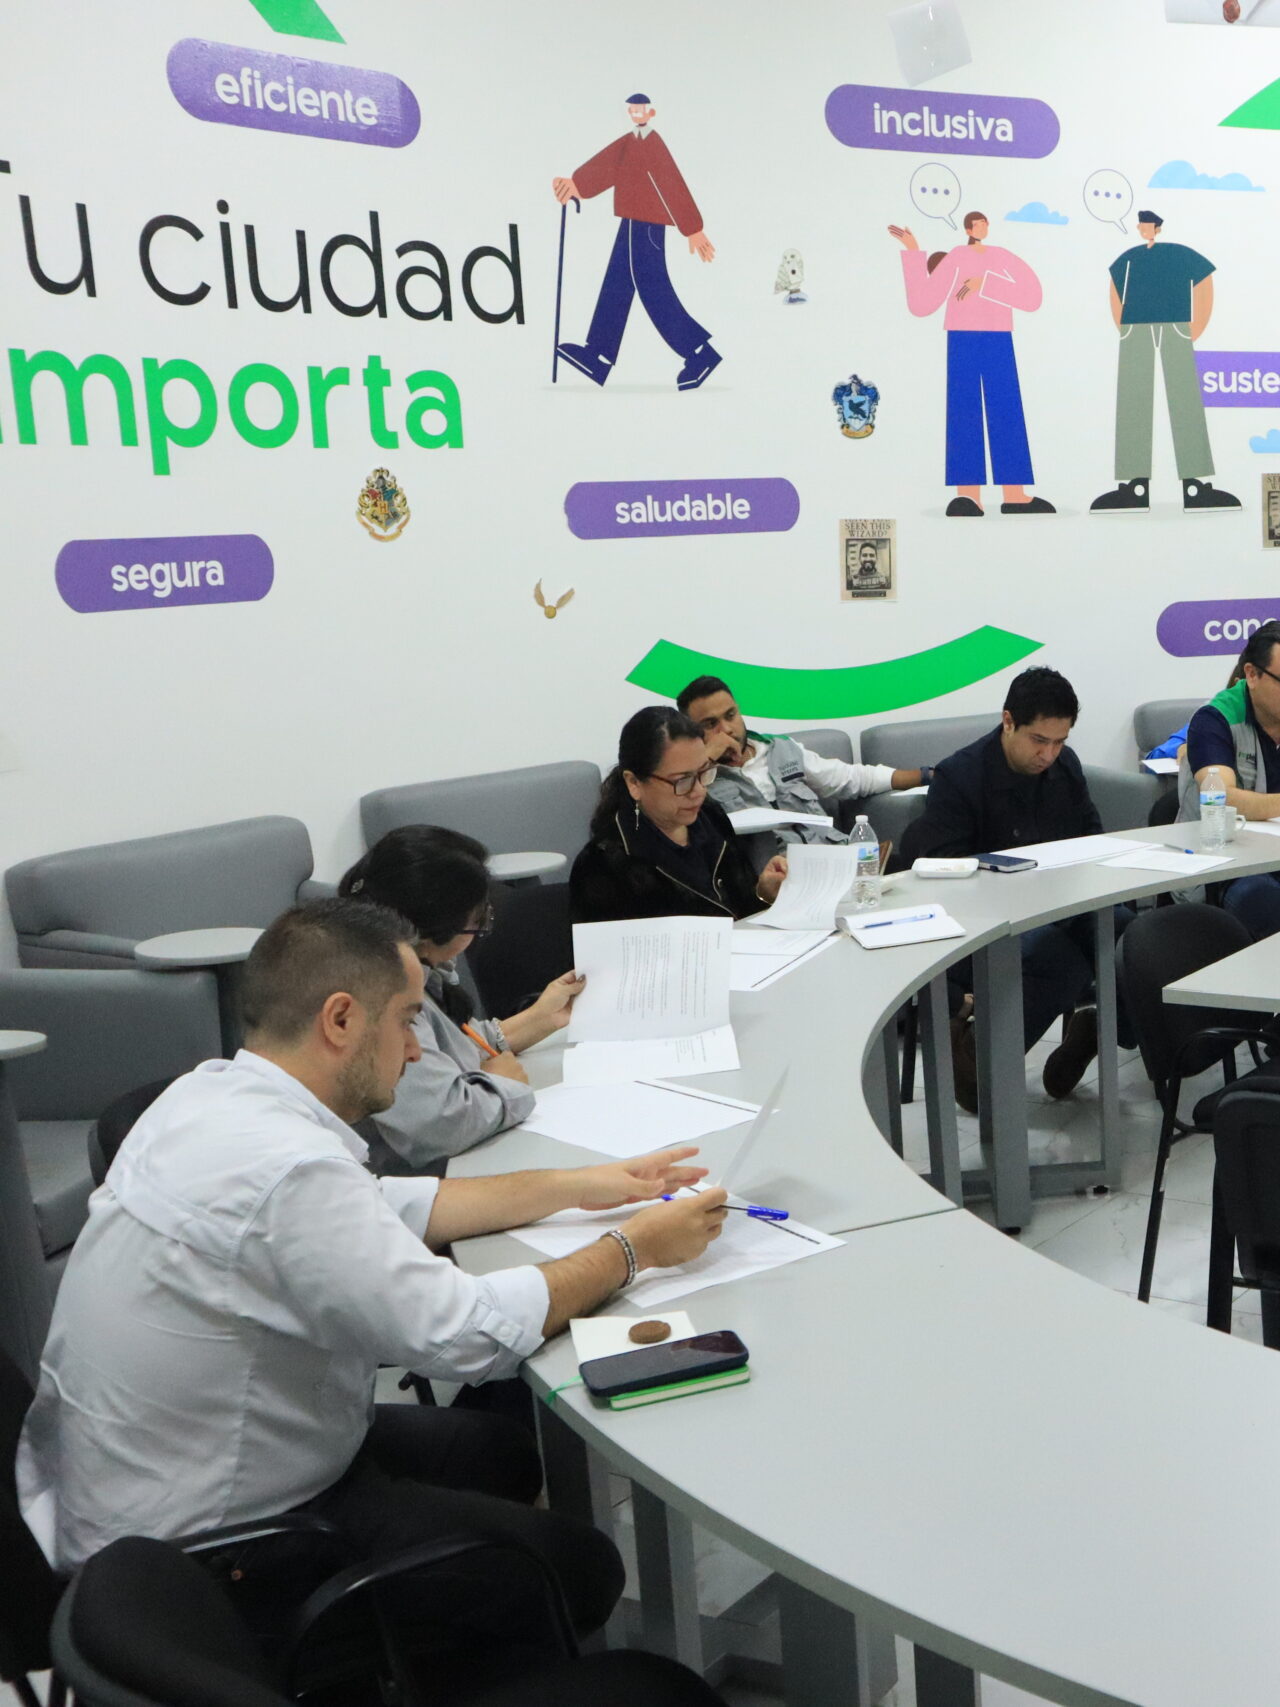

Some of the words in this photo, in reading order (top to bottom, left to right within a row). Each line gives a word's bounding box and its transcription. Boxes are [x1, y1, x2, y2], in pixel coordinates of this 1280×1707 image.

[215, 66, 379, 126] eficiente
[873, 102, 1014, 142] inclusiva
[0, 159, 97, 298] u
[139, 199, 525, 325] ciudad
[0, 348, 464, 476] mporta
[615, 492, 751, 525] saludable
[845, 522, 868, 530] SEEN
[870, 522, 891, 530] THIS
[111, 560, 225, 598] segura
